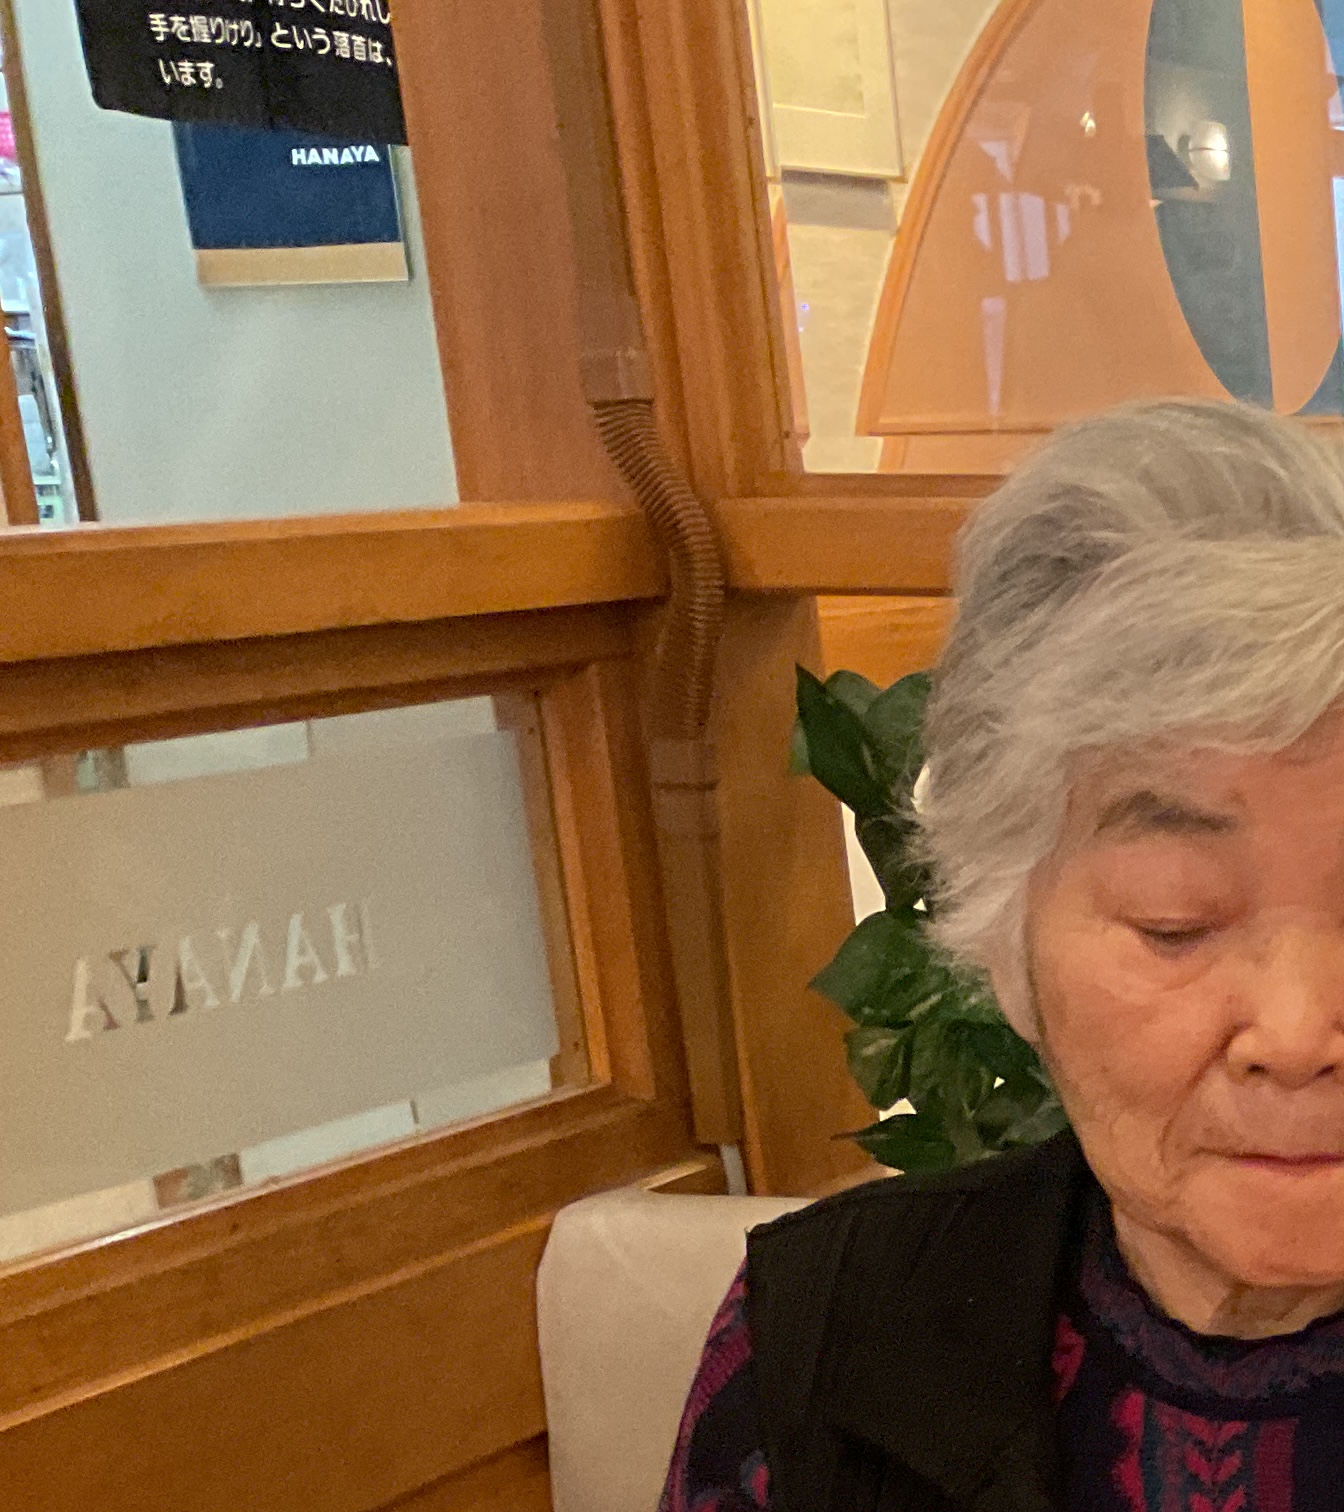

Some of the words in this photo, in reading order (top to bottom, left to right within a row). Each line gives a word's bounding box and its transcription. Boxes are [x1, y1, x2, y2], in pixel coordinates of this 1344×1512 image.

[158, 58, 223, 89] います。
[292, 145, 380, 166] HANAYA
